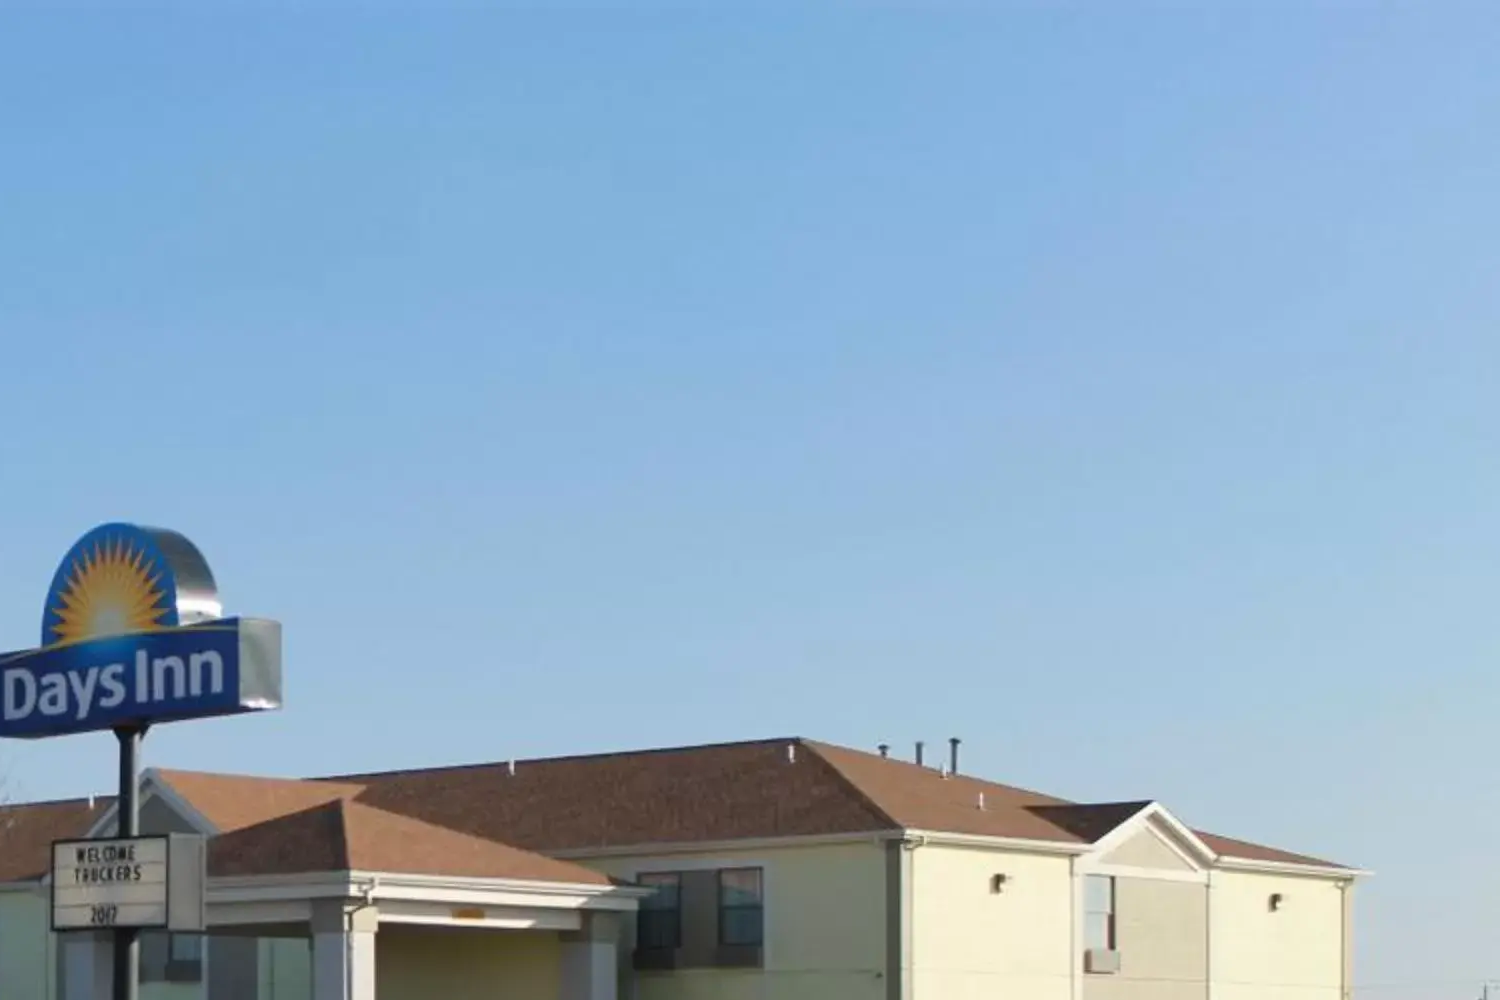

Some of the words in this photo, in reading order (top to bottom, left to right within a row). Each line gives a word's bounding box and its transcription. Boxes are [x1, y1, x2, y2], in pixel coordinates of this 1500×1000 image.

[3, 663, 126, 721] Days
[135, 648, 224, 704] Inn
[76, 844, 136, 864] WELCOME
[74, 864, 142, 884] TRUCKERS
